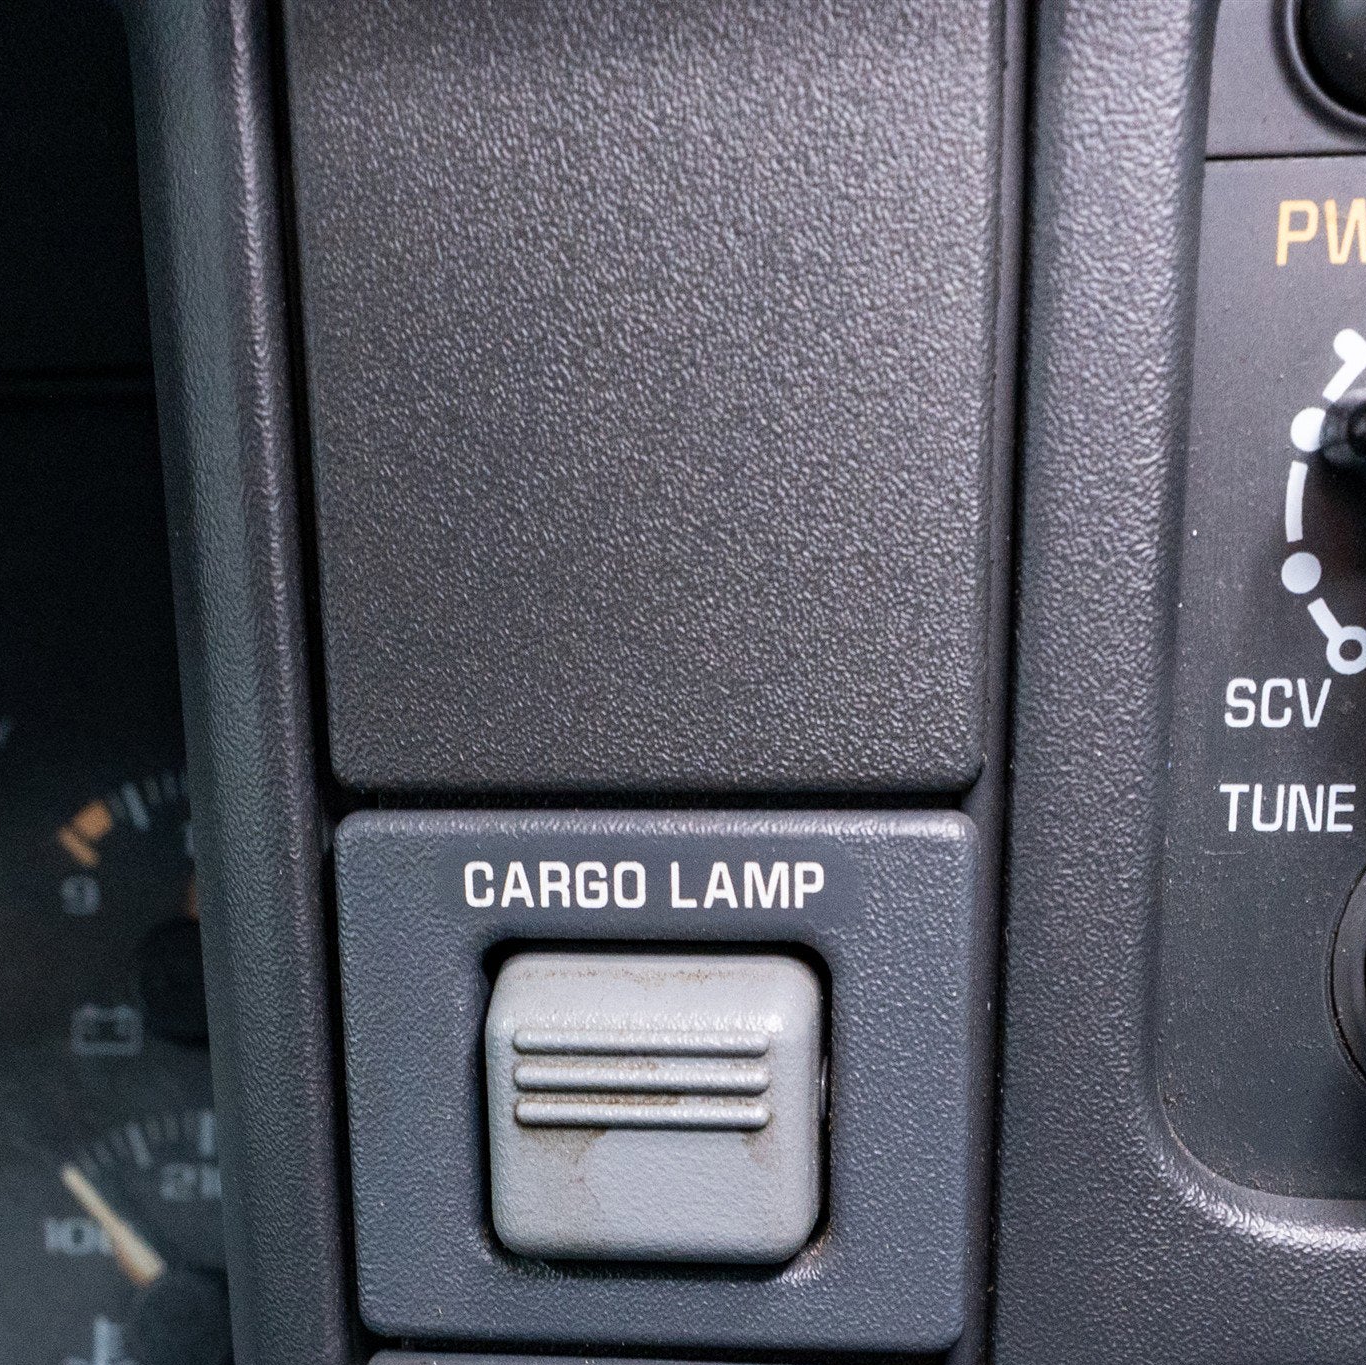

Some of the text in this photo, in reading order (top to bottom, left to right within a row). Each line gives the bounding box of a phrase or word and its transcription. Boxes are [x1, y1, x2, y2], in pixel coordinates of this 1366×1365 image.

[1223, 676, 1334, 729] SCV
[1219, 782, 1357, 834] TUNE
[463, 860, 827, 911] CARGO LAMP
